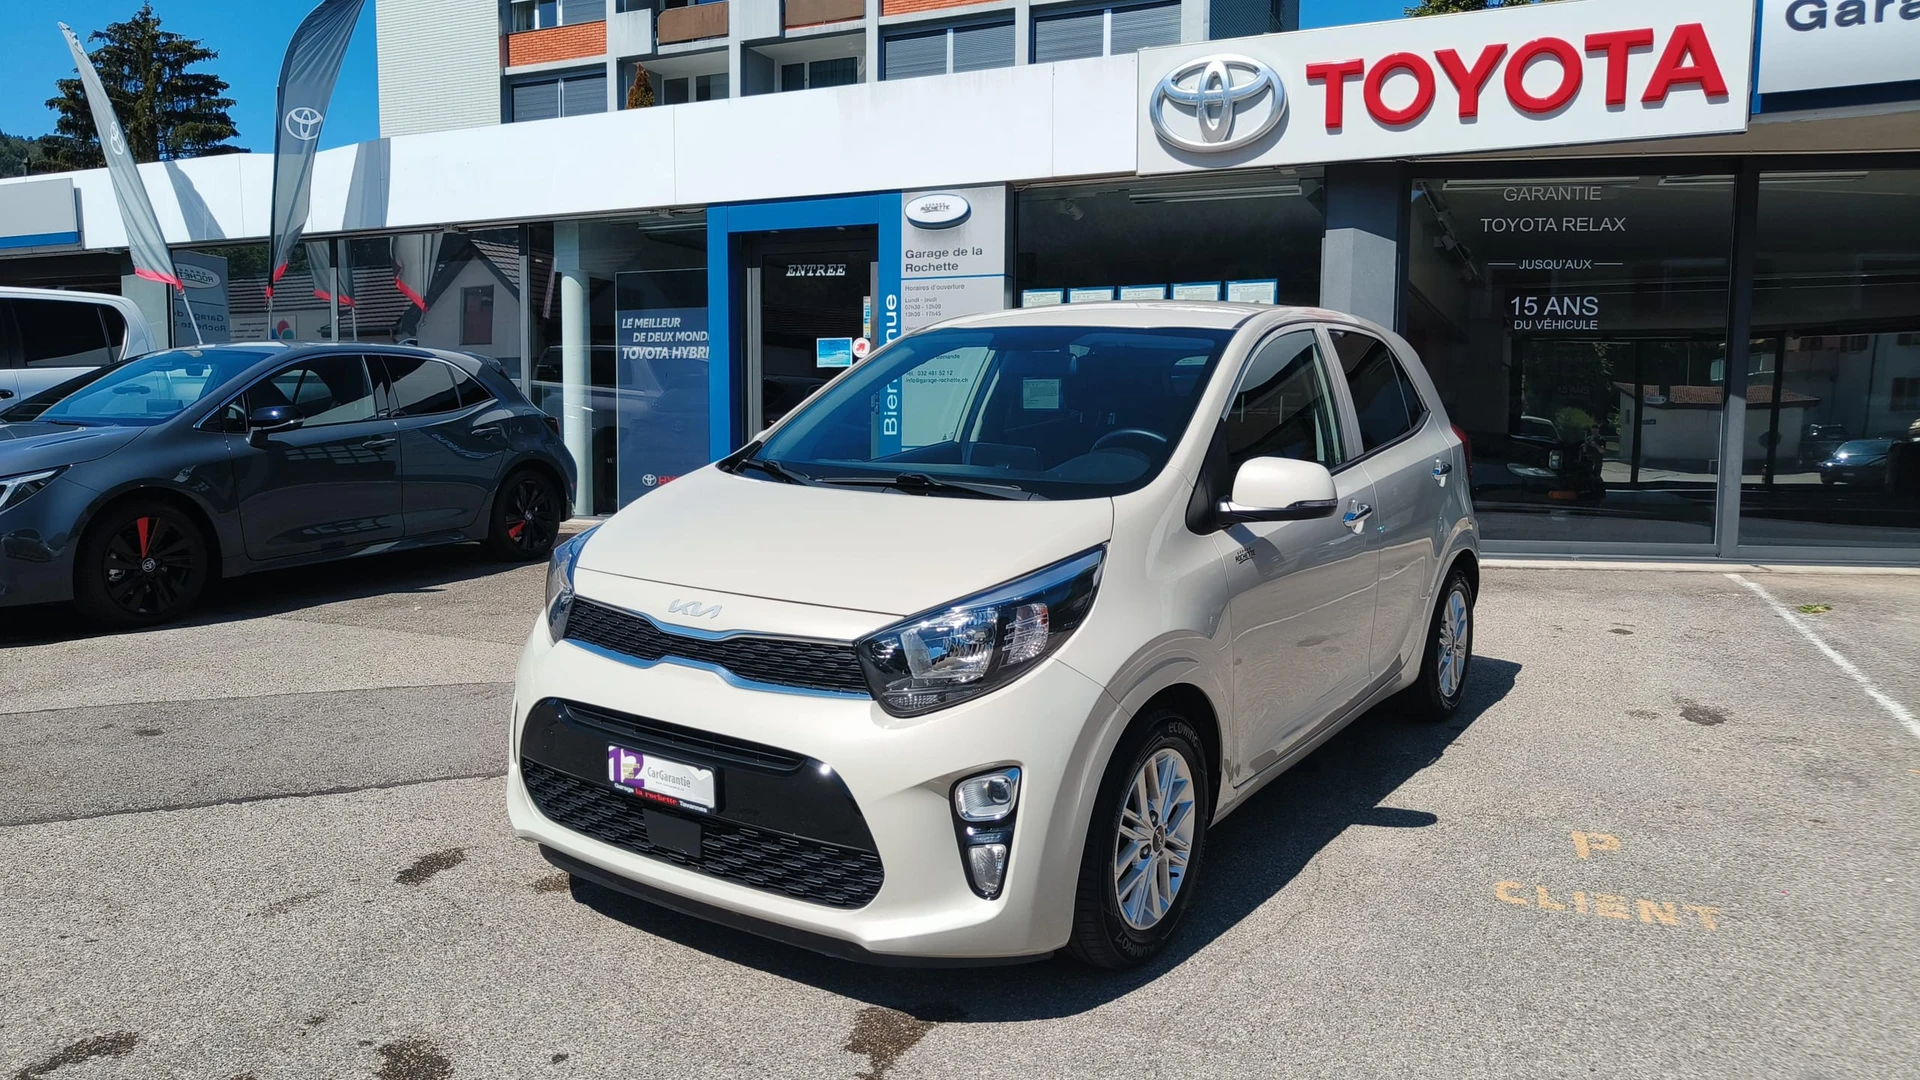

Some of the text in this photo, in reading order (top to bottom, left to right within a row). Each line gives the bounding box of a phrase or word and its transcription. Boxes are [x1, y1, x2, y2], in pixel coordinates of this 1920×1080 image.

[1306, 22, 1728, 131] TOYOTA
[1503, 186, 1602, 201] GARANTIE
[1480, 217, 1626, 232] TOYOTA RELAX
[905, 246, 983, 260] Garage de la
[786, 264, 846, 277] ENTREE
[905, 262, 959, 273] Rochette
[1518, 259, 1592, 270] JUSQU'AUX
[1511, 296, 1599, 316] 15 ANS
[634, 318, 681, 329] MEILLEUR
[1514, 318, 1598, 330] DU VÉHICULE
[633, 331, 709, 342] DE DEUX MOND
[622, 347, 669, 360] TOYOTA
[647, 766, 691, 788] CarGarantie
[1571, 830, 1621, 860] P
[1495, 880, 1720, 931] CLIENT
